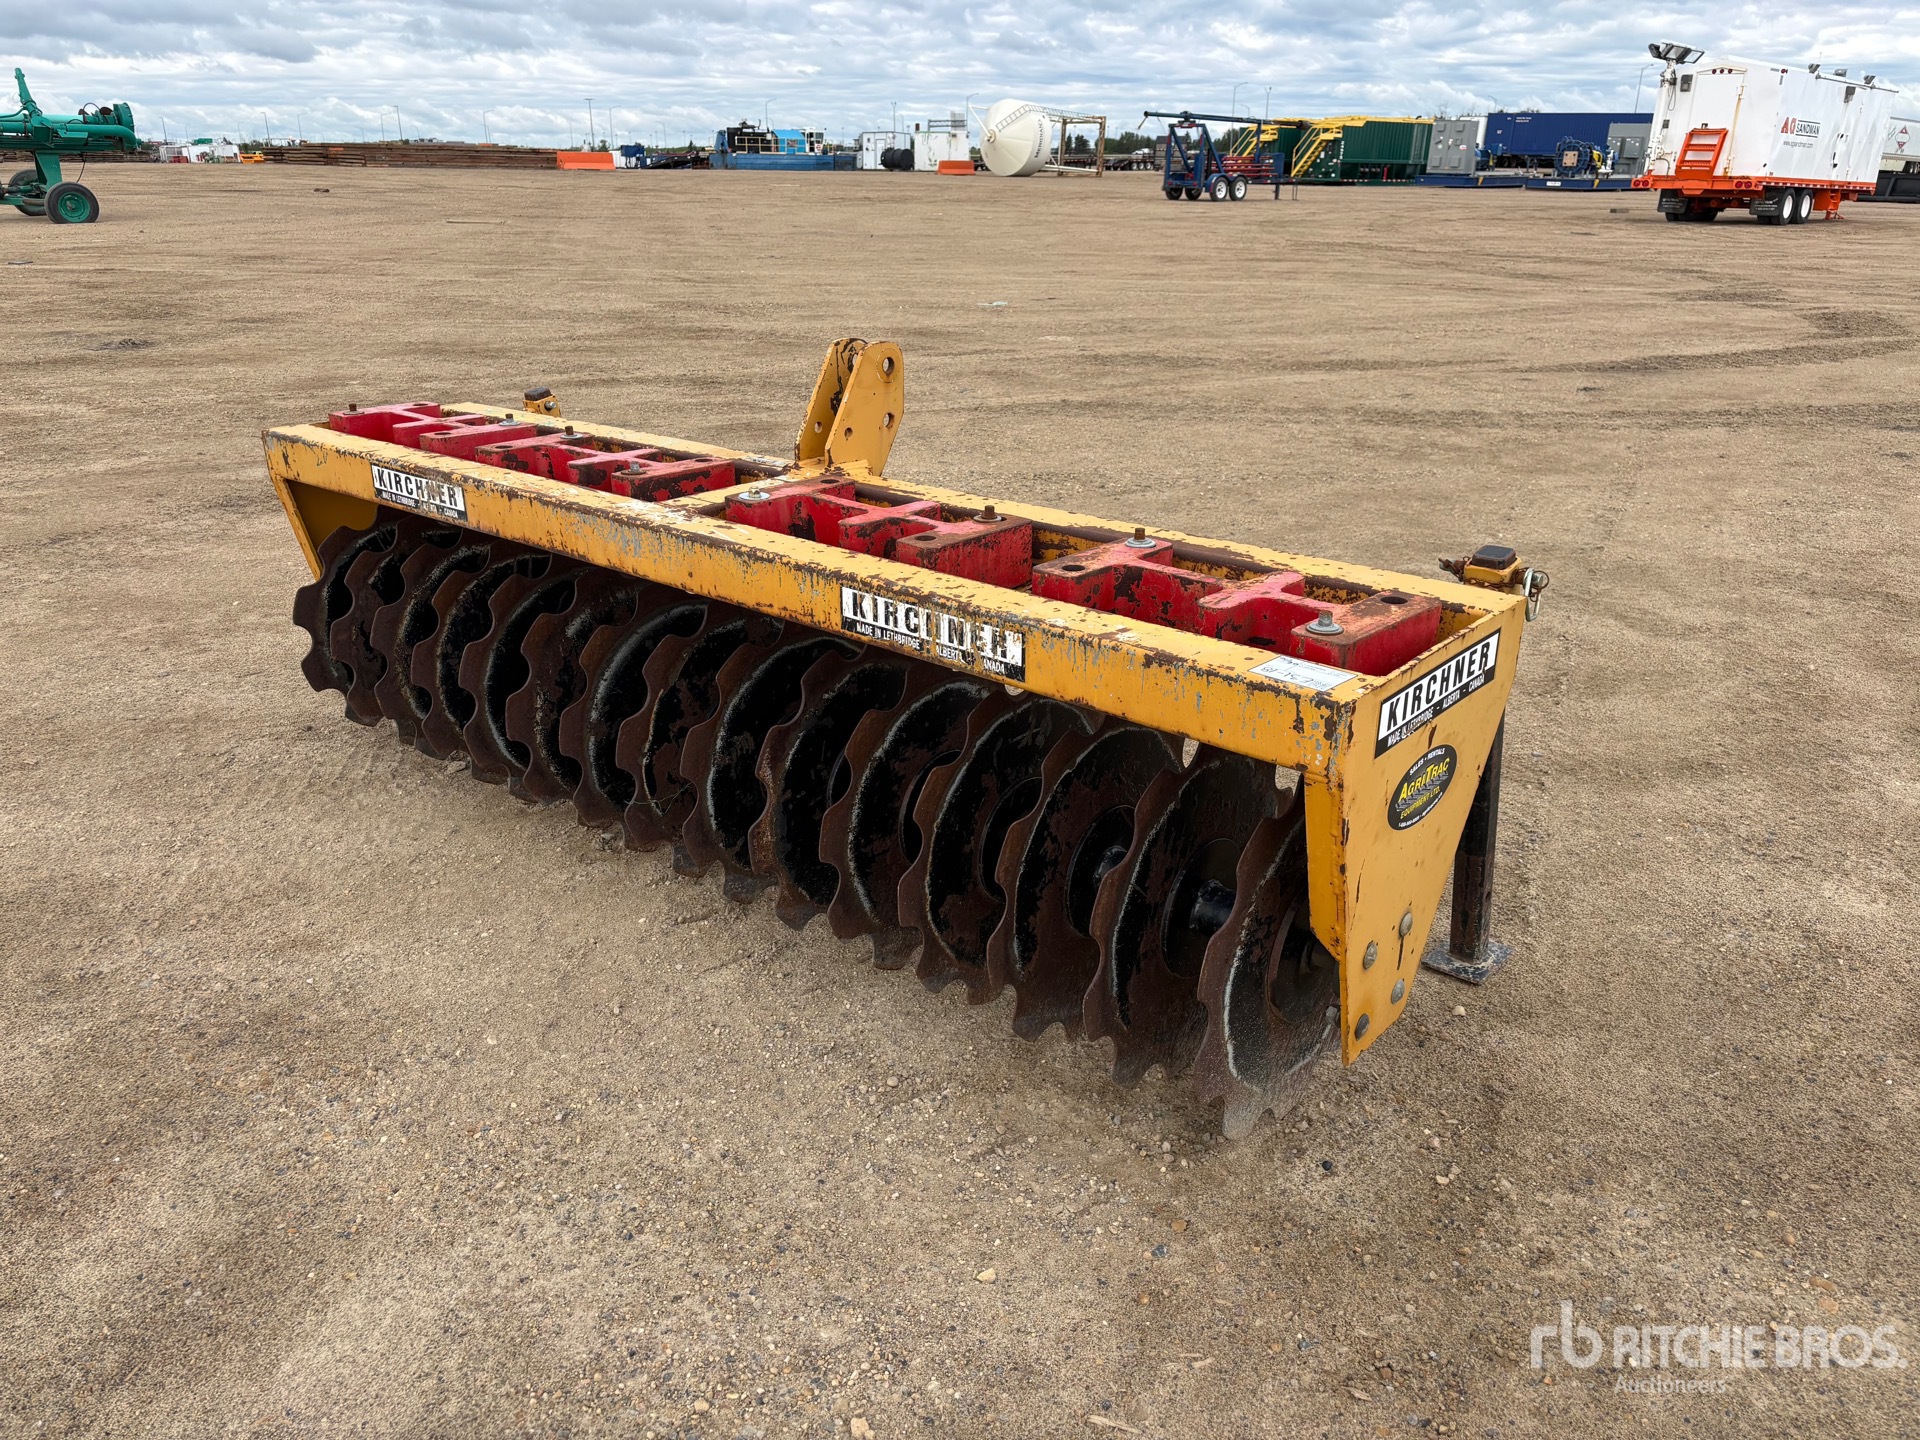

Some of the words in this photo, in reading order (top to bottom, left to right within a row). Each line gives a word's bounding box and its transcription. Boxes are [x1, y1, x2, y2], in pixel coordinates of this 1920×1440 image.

[1796, 123, 1820, 135] SANDMAN
[857, 622, 873, 636] MADE
[883, 630, 921, 650] LETHBRIDGE
[983, 659, 1005, 675] ANADA
[1387, 641, 1490, 732] KIRCHNER
[1387, 728, 1402, 748] MADE
[1442, 690, 1460, 709] ALBERTA
[1469, 673, 1485, 692] CANADA
[1410, 758, 1424, 776] SALES
[1427, 747, 1445, 760] RENTALS
[1400, 792, 1430, 819] EQUIPMENT
